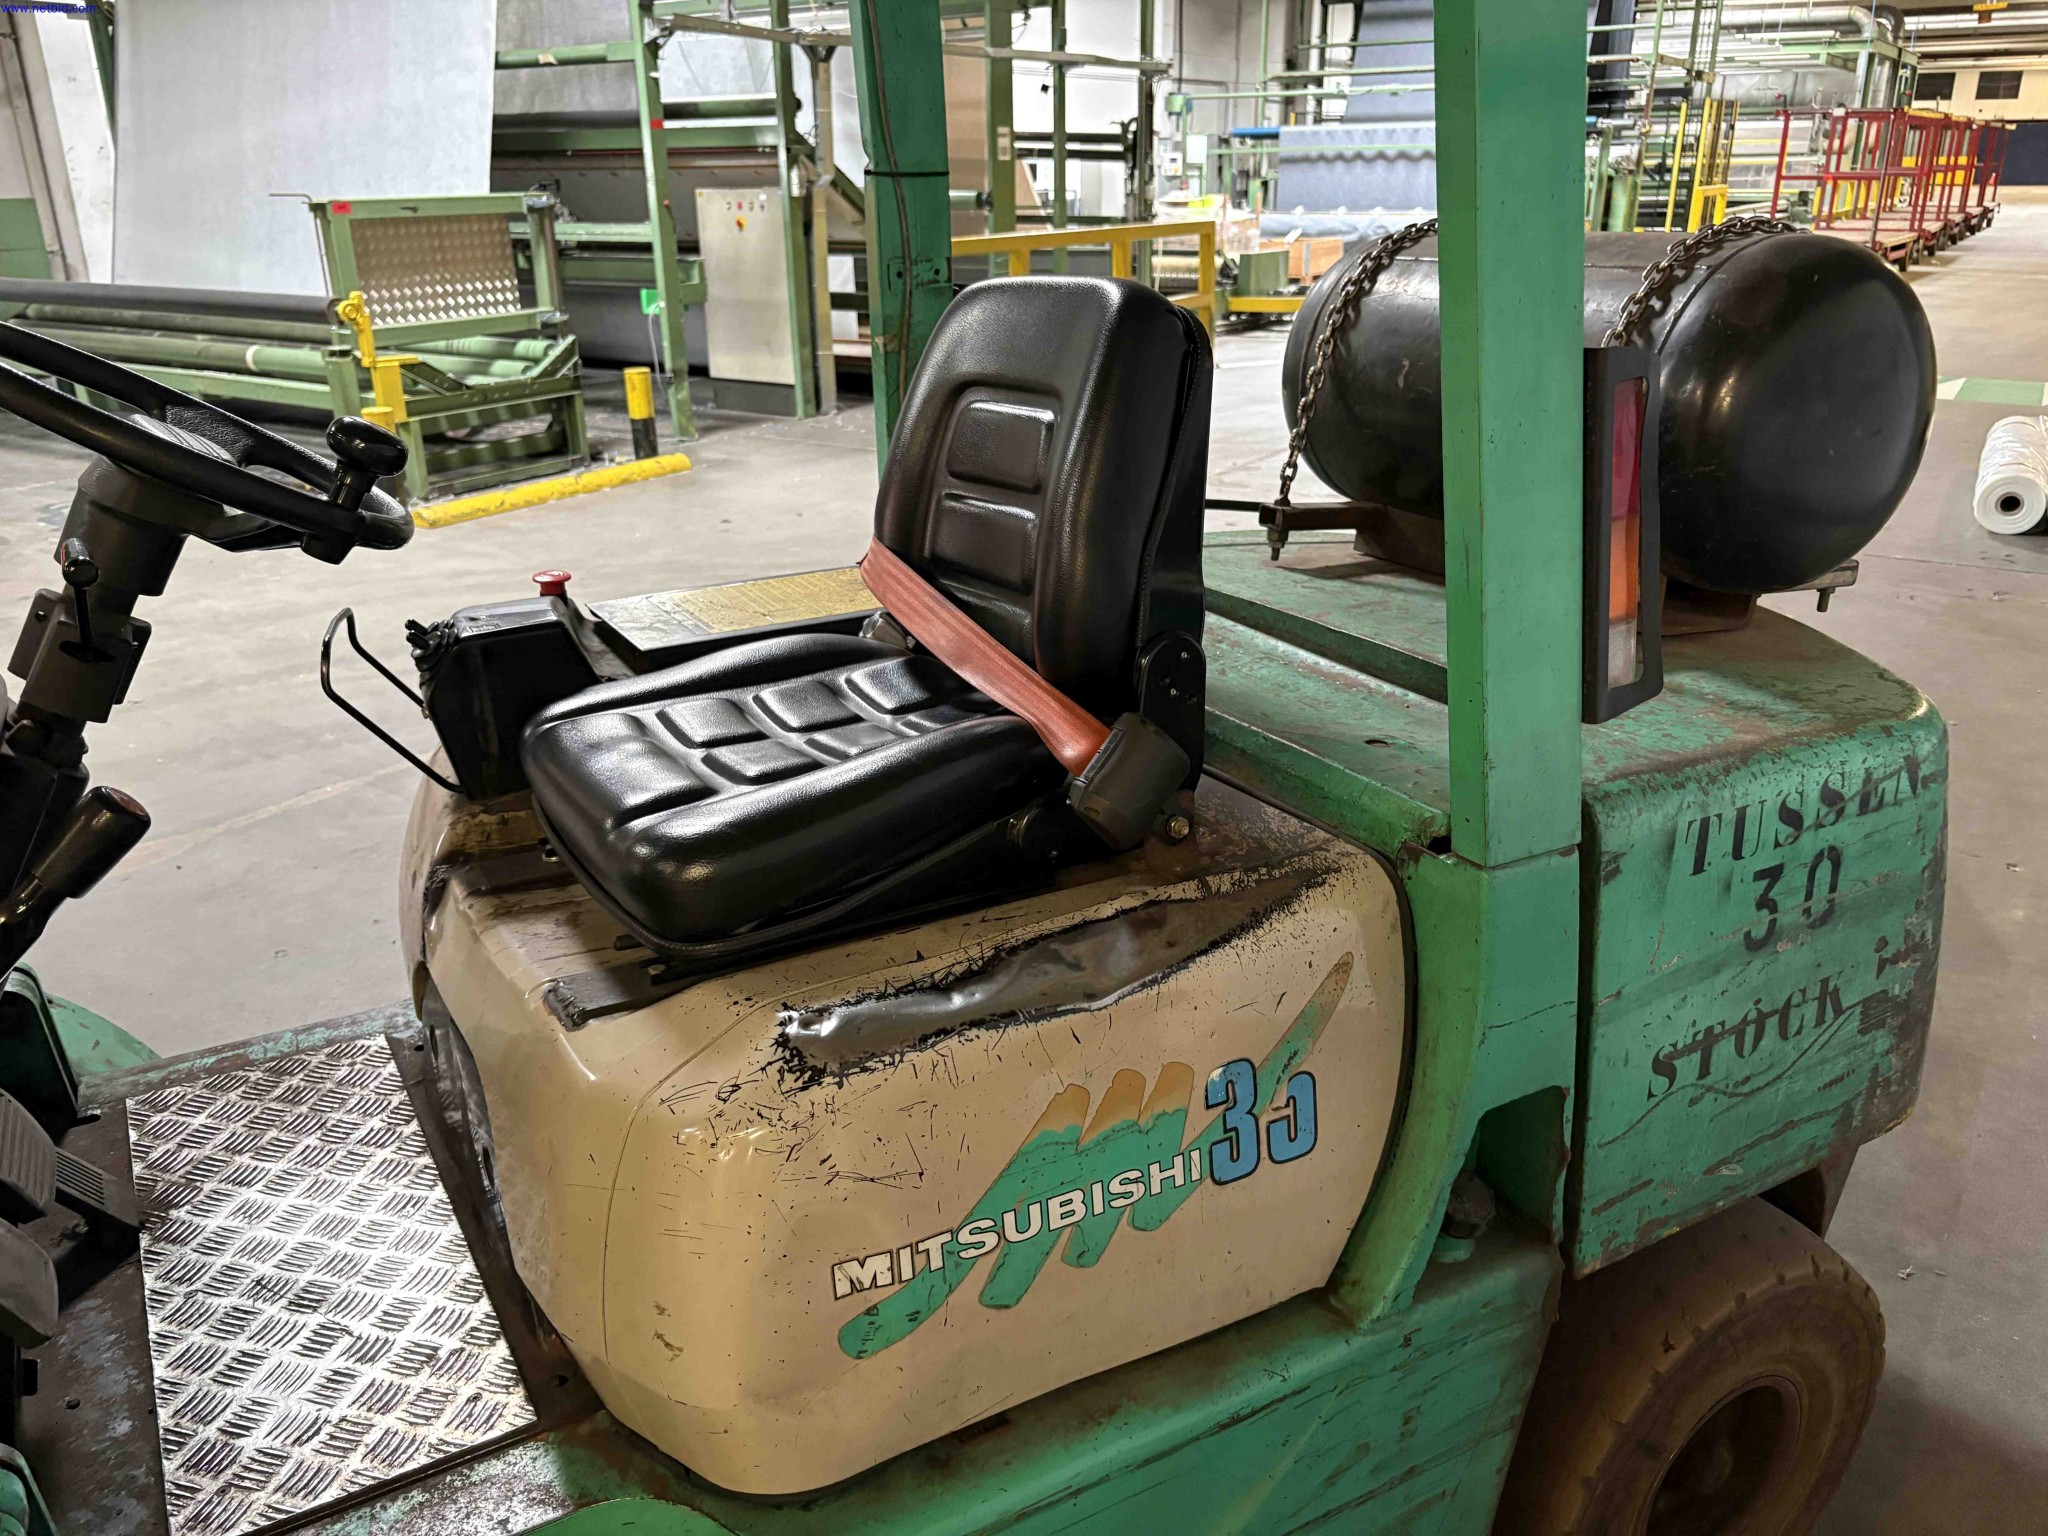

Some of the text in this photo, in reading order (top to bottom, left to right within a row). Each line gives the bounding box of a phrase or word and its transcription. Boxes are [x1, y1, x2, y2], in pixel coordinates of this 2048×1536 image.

[1743, 845, 1842, 952] 30
[1646, 970, 1845, 1101] STOCK
[831, 1147, 1203, 1300] MITSUBISHI
